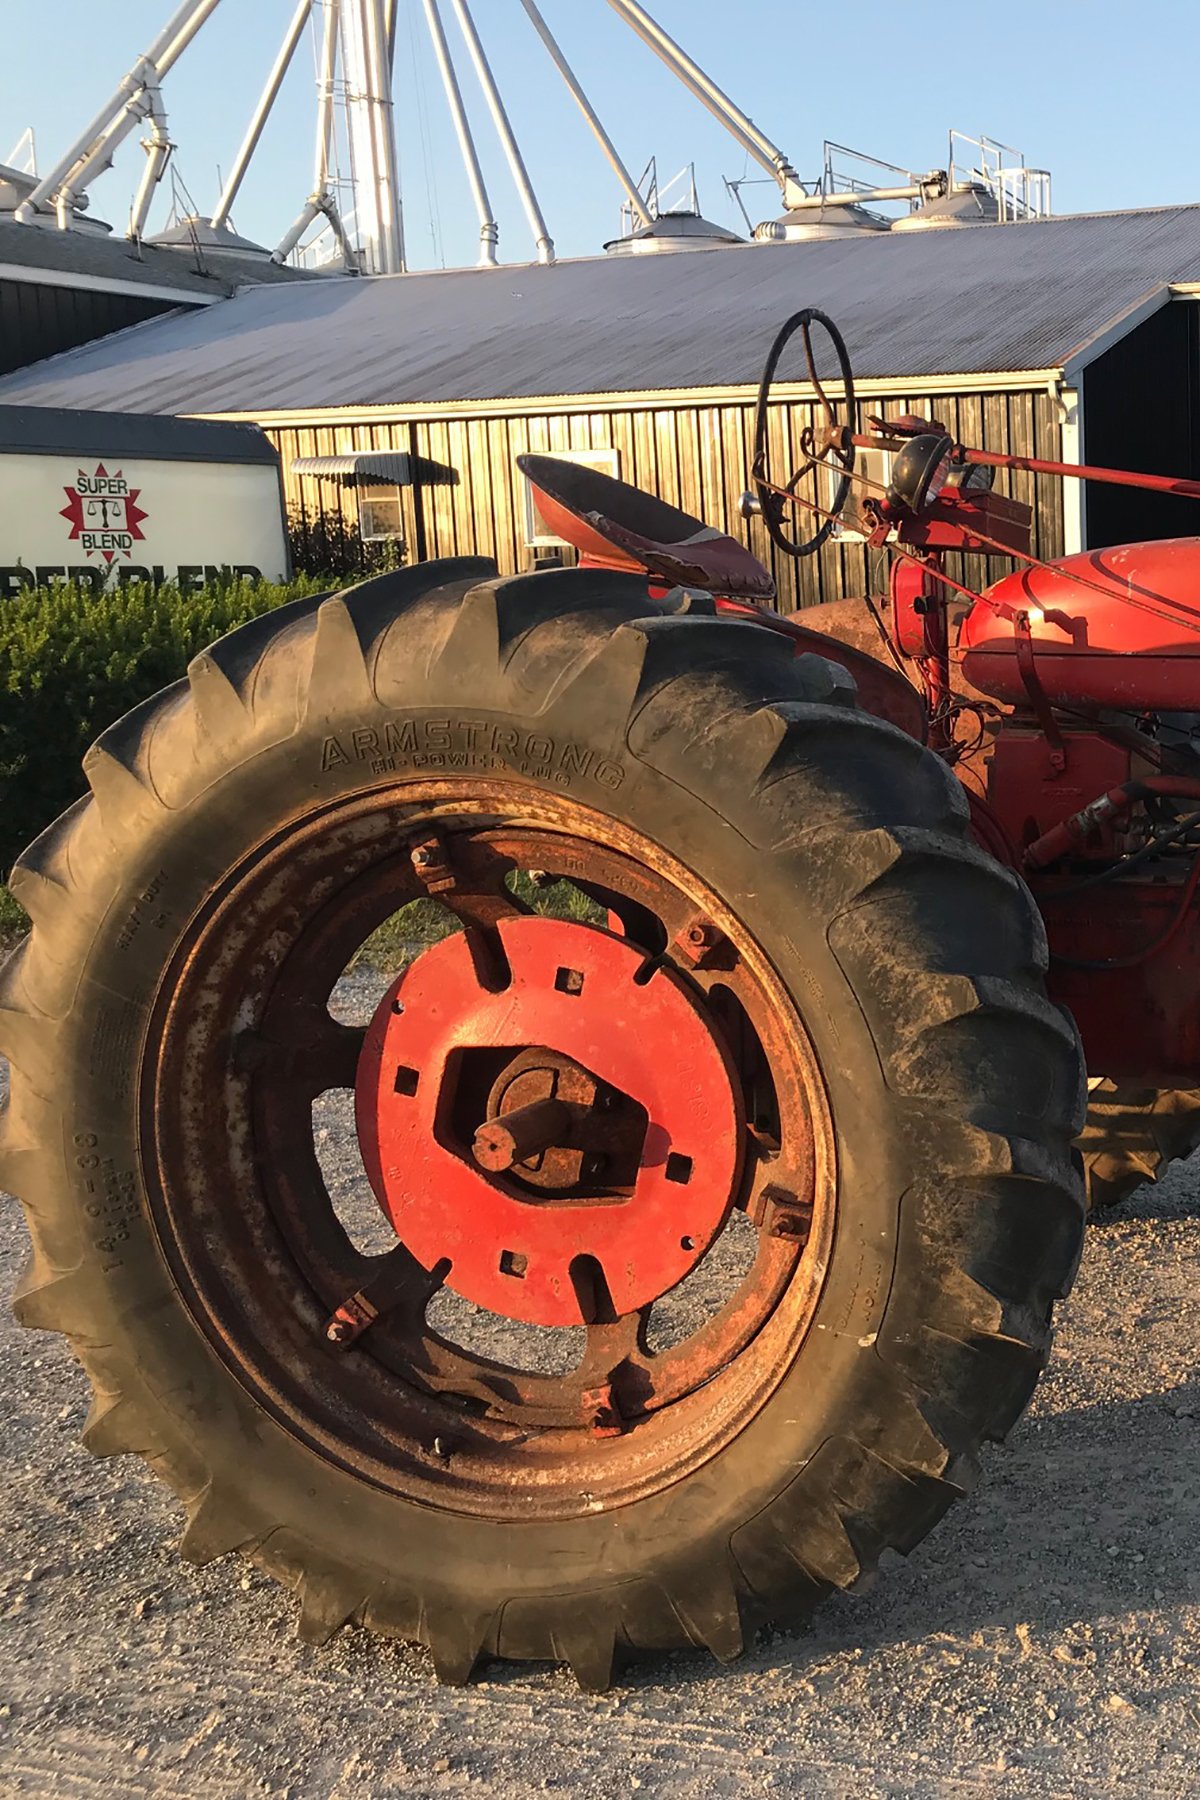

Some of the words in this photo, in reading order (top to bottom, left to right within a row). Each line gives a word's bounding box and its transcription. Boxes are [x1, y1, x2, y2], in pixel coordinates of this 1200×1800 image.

[77, 477, 128, 494] SUPER
[82, 534, 132, 549] BLEND
[320, 718, 627, 791] ARMSTRONG
[519, 761, 572, 786] LUG
[140, 869, 169, 904] DUTY
